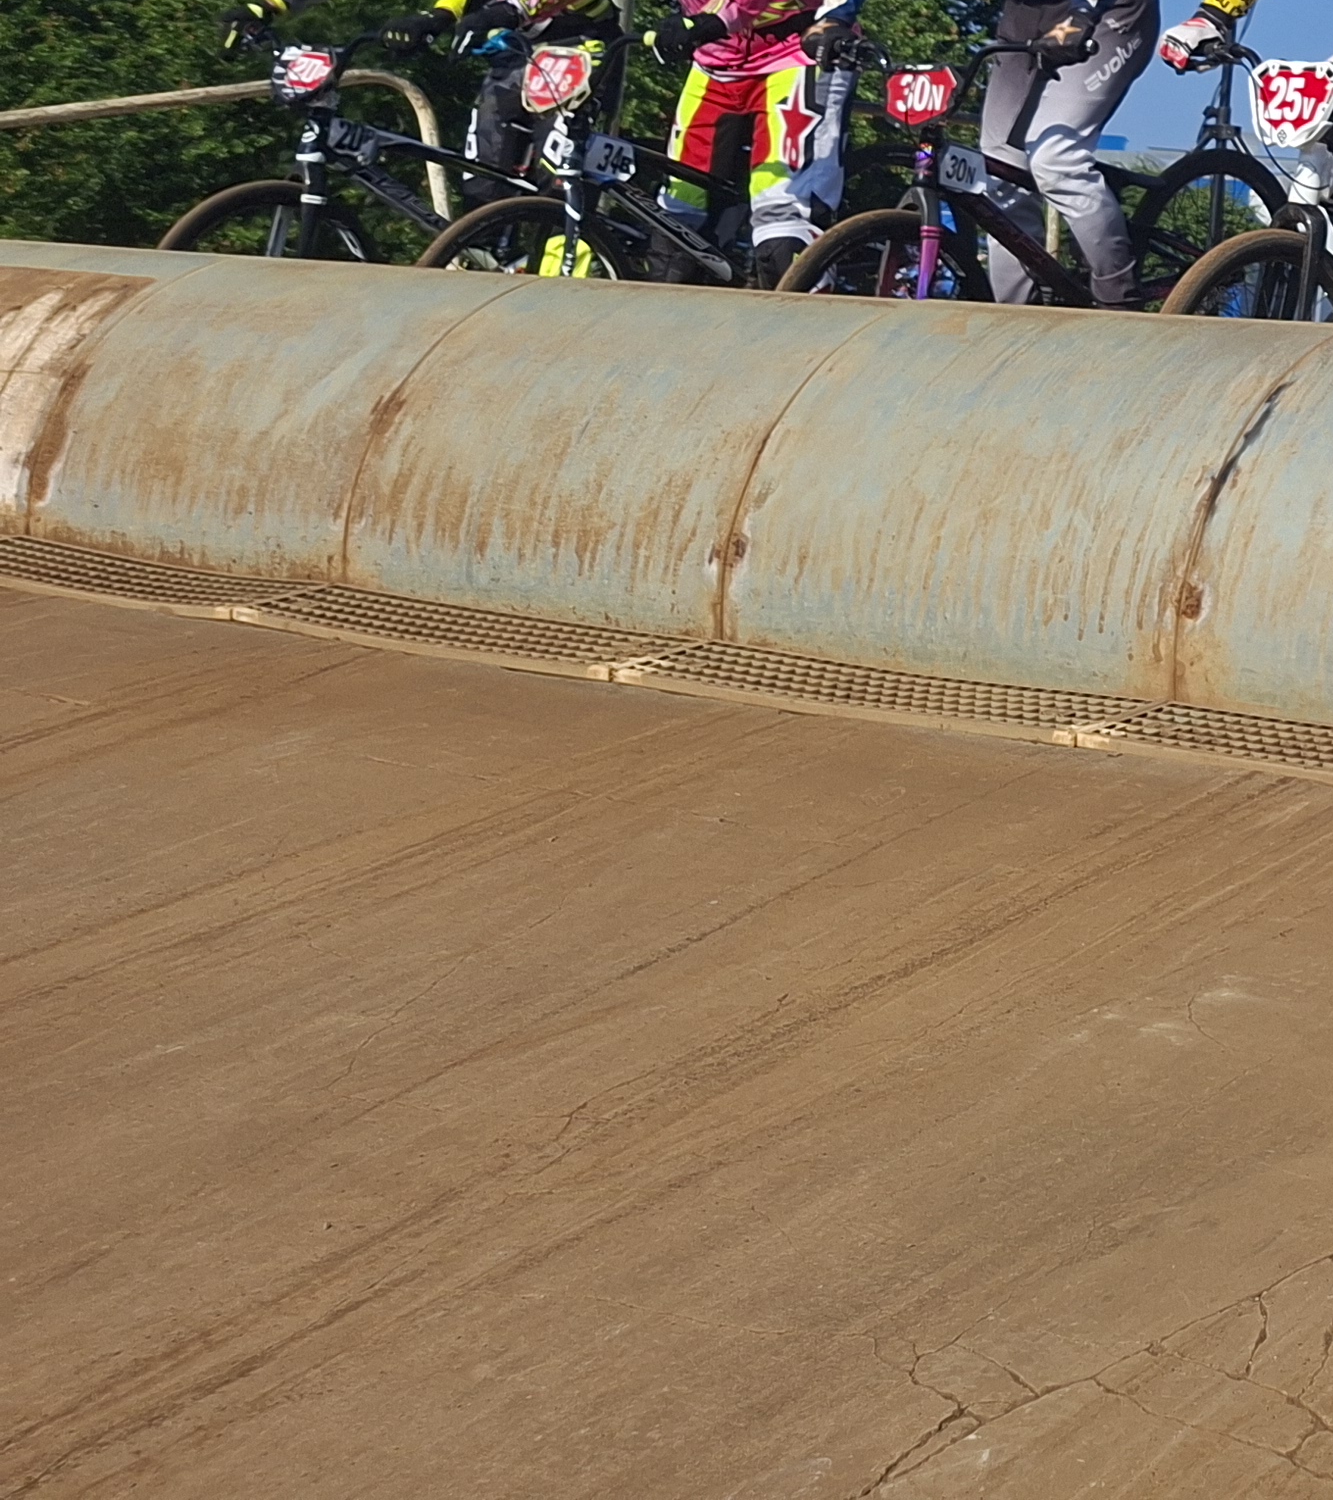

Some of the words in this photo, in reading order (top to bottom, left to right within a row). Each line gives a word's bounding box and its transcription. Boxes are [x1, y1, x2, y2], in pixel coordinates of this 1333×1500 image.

[896, 74, 945, 113] 30N
[596, 143, 631, 175] 34B
[945, 155, 976, 184] 30N
